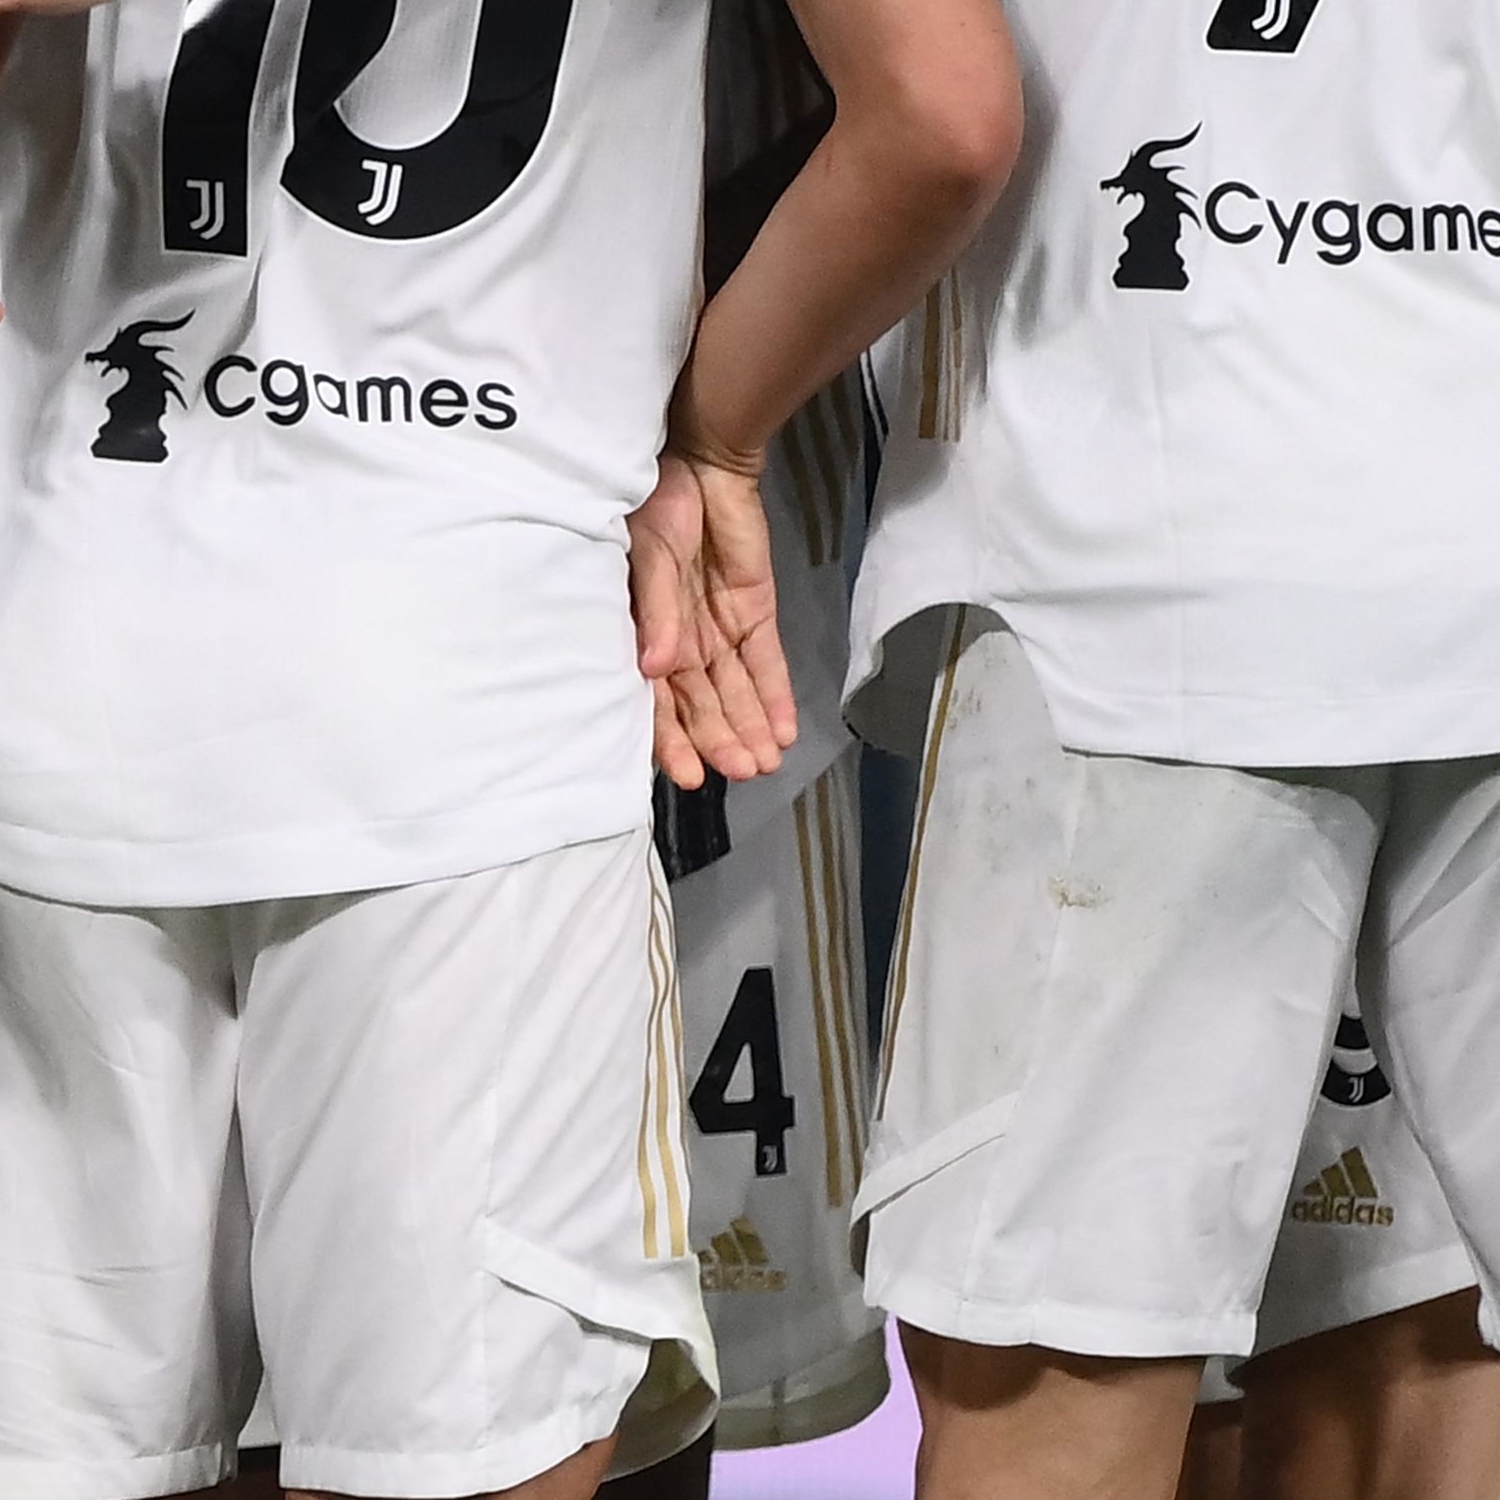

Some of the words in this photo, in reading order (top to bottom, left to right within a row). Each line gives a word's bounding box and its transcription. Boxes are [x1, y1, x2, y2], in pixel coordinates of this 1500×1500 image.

[203, 354, 518, 431] Cgames
[688, 967, 796, 1176] 4
[1291, 1196, 1395, 1227] adidas
